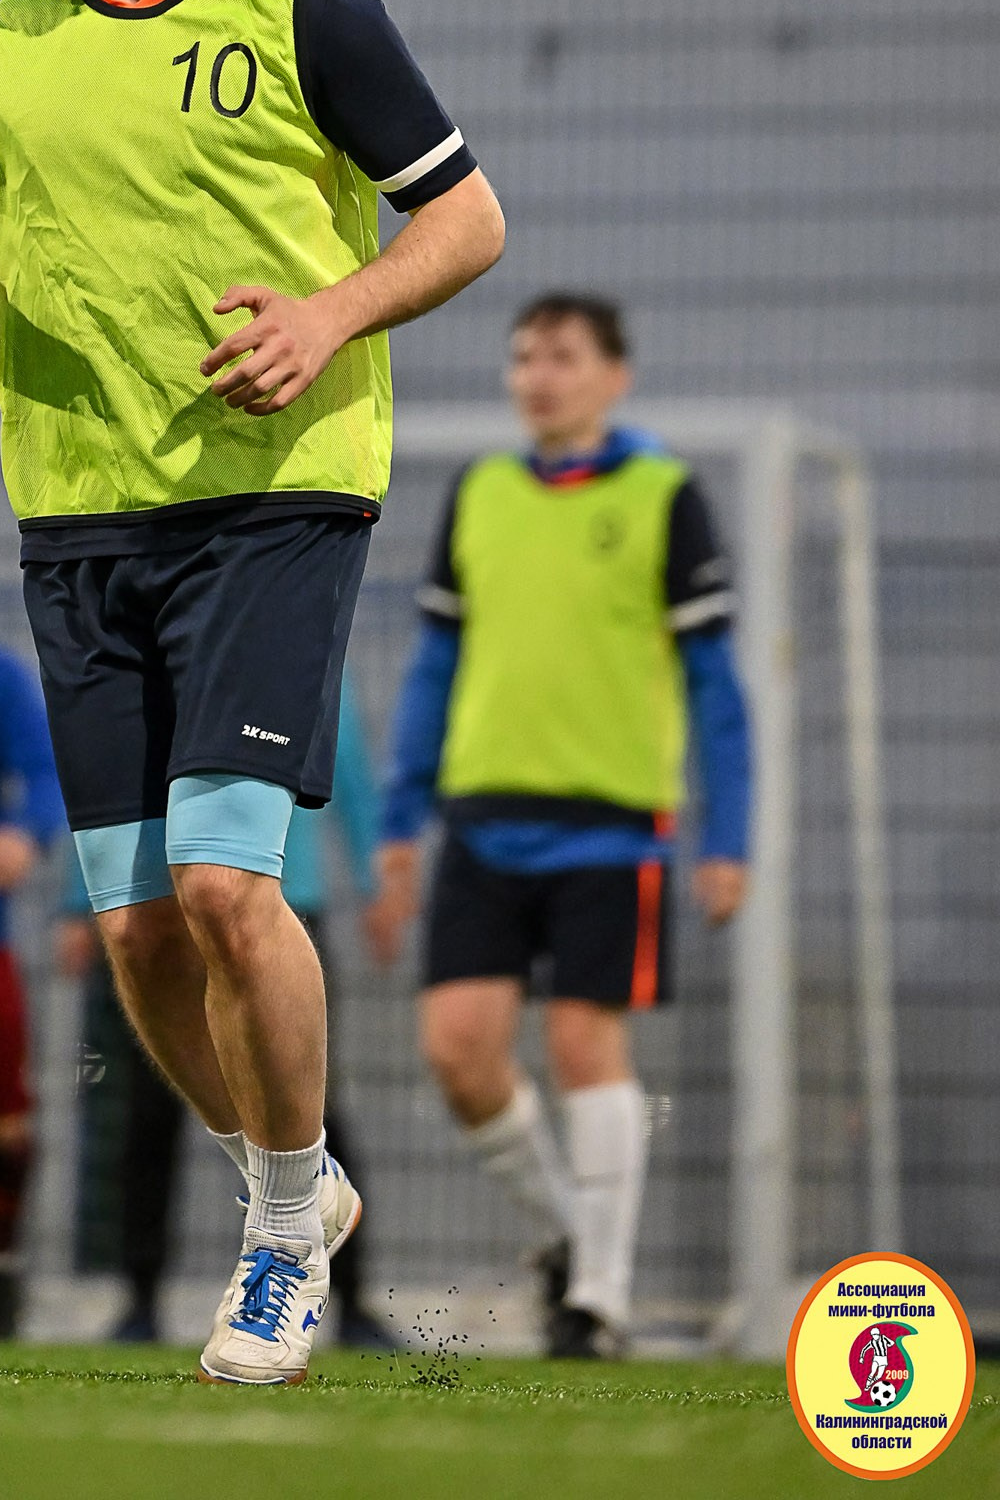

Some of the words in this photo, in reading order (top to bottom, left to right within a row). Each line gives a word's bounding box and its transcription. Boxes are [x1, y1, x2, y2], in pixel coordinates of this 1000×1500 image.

[172, 41, 257, 118] 10
[241, 724, 261, 738] 2K
[259, 730, 291, 746] SPORT
